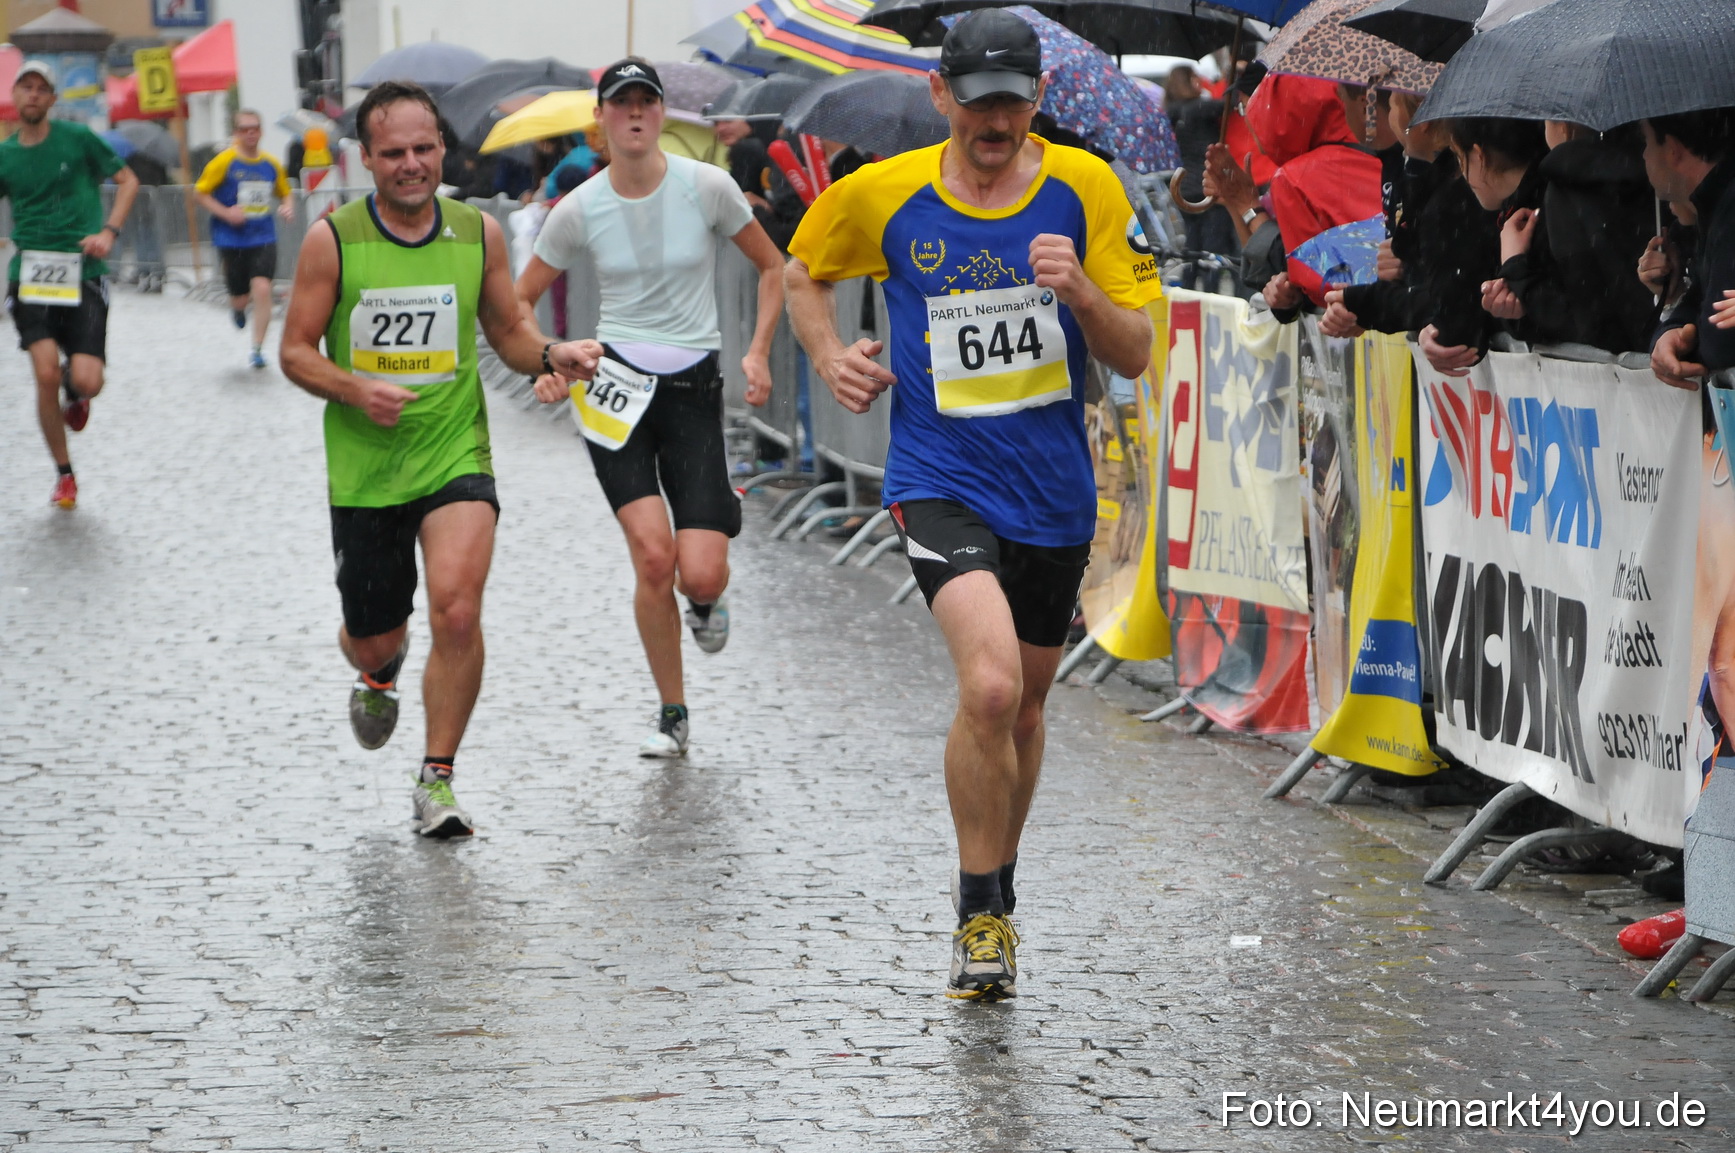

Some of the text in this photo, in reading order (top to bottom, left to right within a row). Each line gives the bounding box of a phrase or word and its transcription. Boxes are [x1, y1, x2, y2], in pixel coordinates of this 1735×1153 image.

[147, 66, 169, 94] D
[918, 252, 938, 260] Jahre
[31, 264, 67, 284] 222
[388, 296, 438, 307] Neumarkt
[931, 297, 1036, 321] PARTL Neumarkt
[372, 311, 436, 346] 227
[957, 316, 1043, 371] 644
[377, 356, 430, 370] Richard
[1598, 712, 1651, 763] 92318
